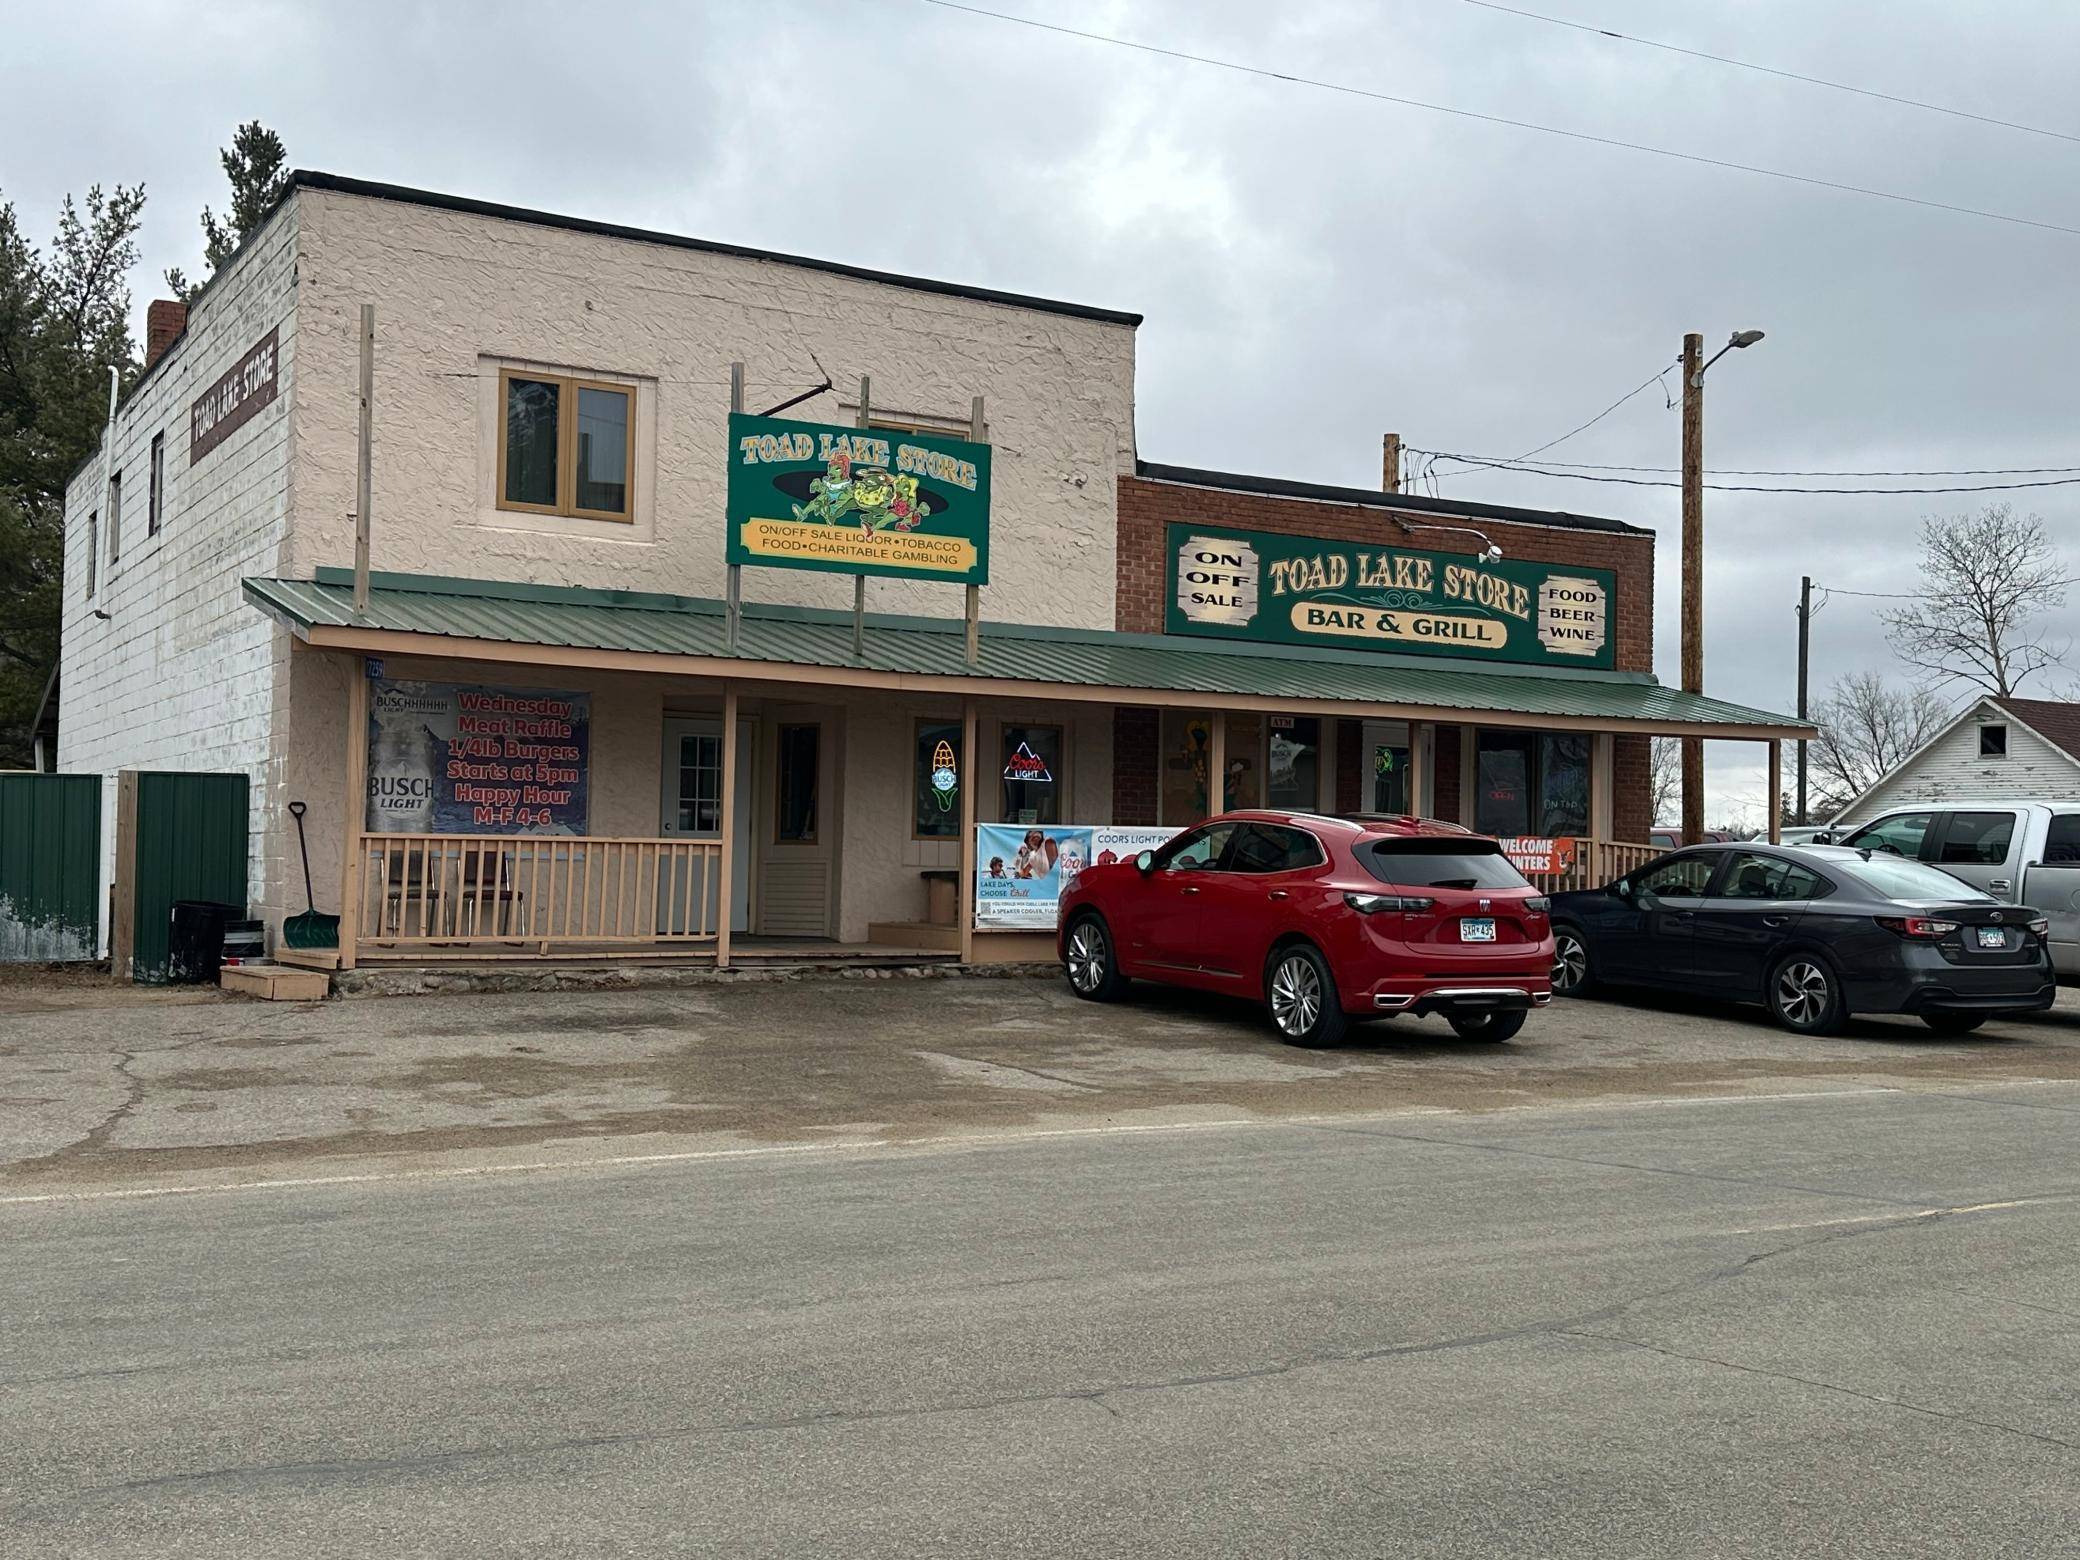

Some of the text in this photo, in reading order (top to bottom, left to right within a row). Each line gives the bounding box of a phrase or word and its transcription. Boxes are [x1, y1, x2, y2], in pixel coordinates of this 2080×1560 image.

[194, 342, 274, 442] TOAD LAKE STORE
[740, 433, 977, 491] TOAD LAKE STORE
[759, 524, 961, 553] ON/OFF SALE LIQUOR TOBACCO
[762, 538, 958, 565] FOOD CHARITABLE GAMBLING
[1194, 552, 1242, 568] ON
[1186, 571, 1250, 587] OFF
[1269, 552, 1531, 622] TOAD LAKE STORE
[1190, 592, 1243, 608] SALE
[1549, 588, 1597, 603] FOOD
[1307, 609, 1492, 642] BAR & GRILL
[1550, 608, 1595, 623] BEER
[1550, 626, 1595, 641] WINE
[457, 692, 572, 718] Wednesday
[458, 715, 572, 738] Meat Raffle
[1272, 718, 1292, 727] ATM
[448, 737, 580, 763] 1/4lb Burgers
[1009, 753, 1046, 770] Coors
[447, 760, 579, 786] Starts at 5pm
[1015, 770, 1039, 779] LIGHT
[368, 777, 433, 798] BUSCH
[455, 783, 571, 807] Happy Hour
[380, 798, 424, 809] LIGHT
[474, 806, 552, 827] M-F 4-6
[1098, 835, 1129, 844] COORS
[1131, 835, 1156, 844] LIGHT
[1499, 838, 1554, 854] WELCOME
